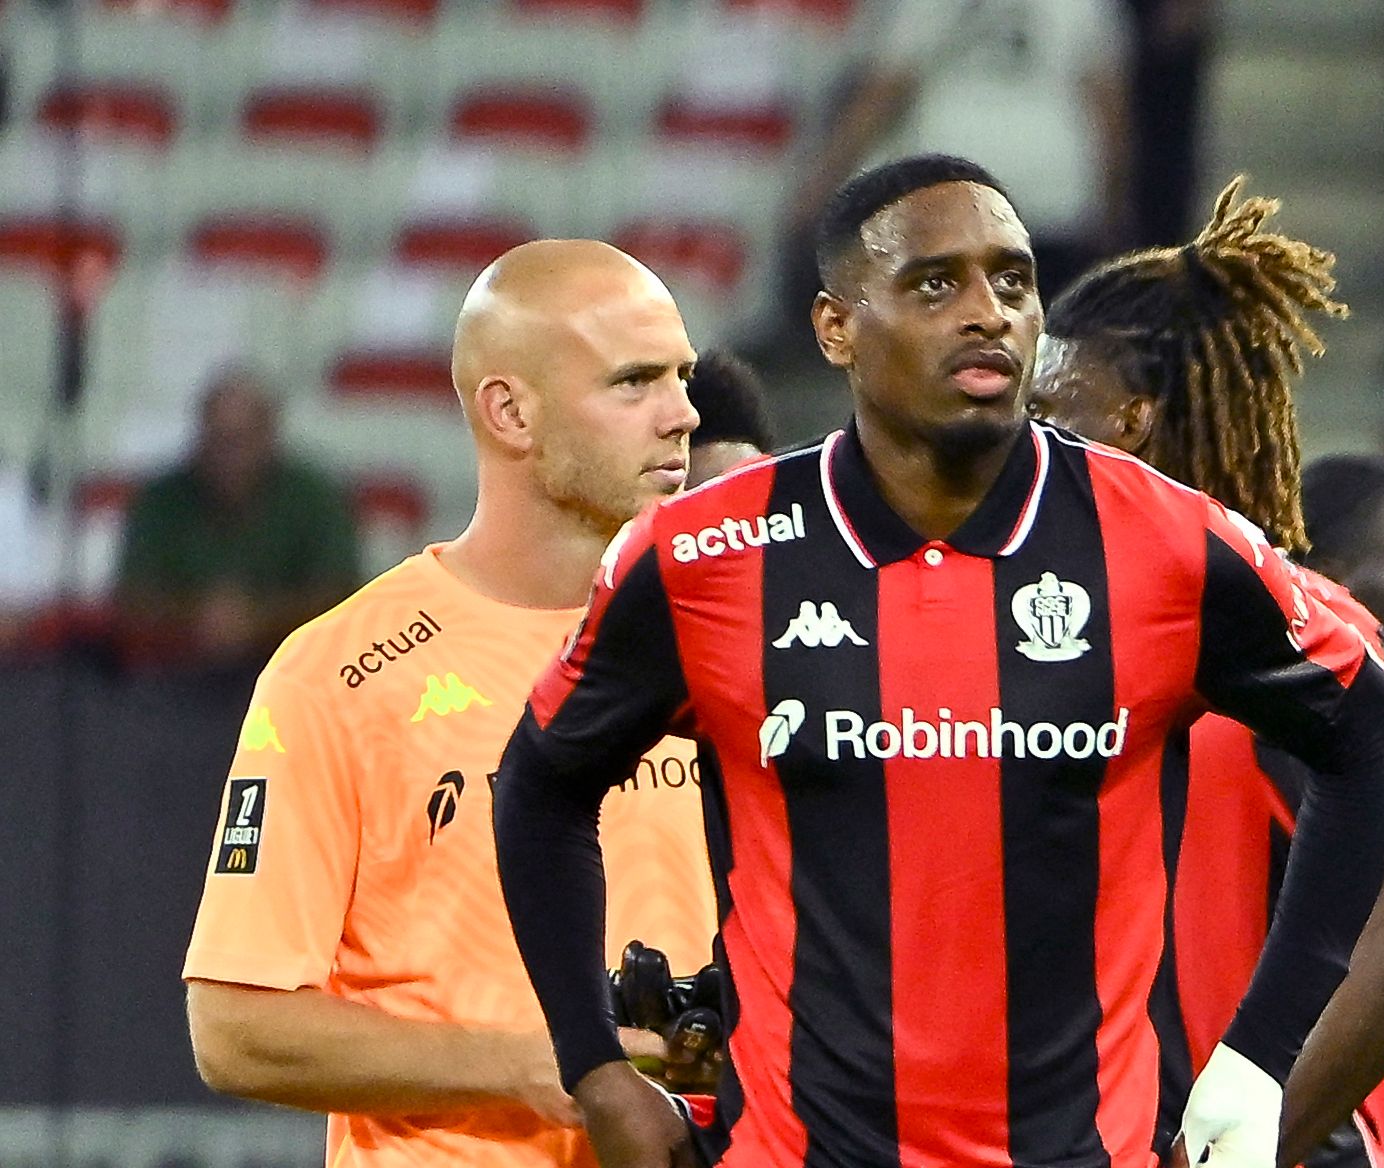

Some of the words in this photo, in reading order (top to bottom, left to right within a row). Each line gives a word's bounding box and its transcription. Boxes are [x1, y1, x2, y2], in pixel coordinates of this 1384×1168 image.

[671, 503, 805, 564] actual
[338, 610, 443, 690] actual
[825, 706, 1128, 760] Robinhood
